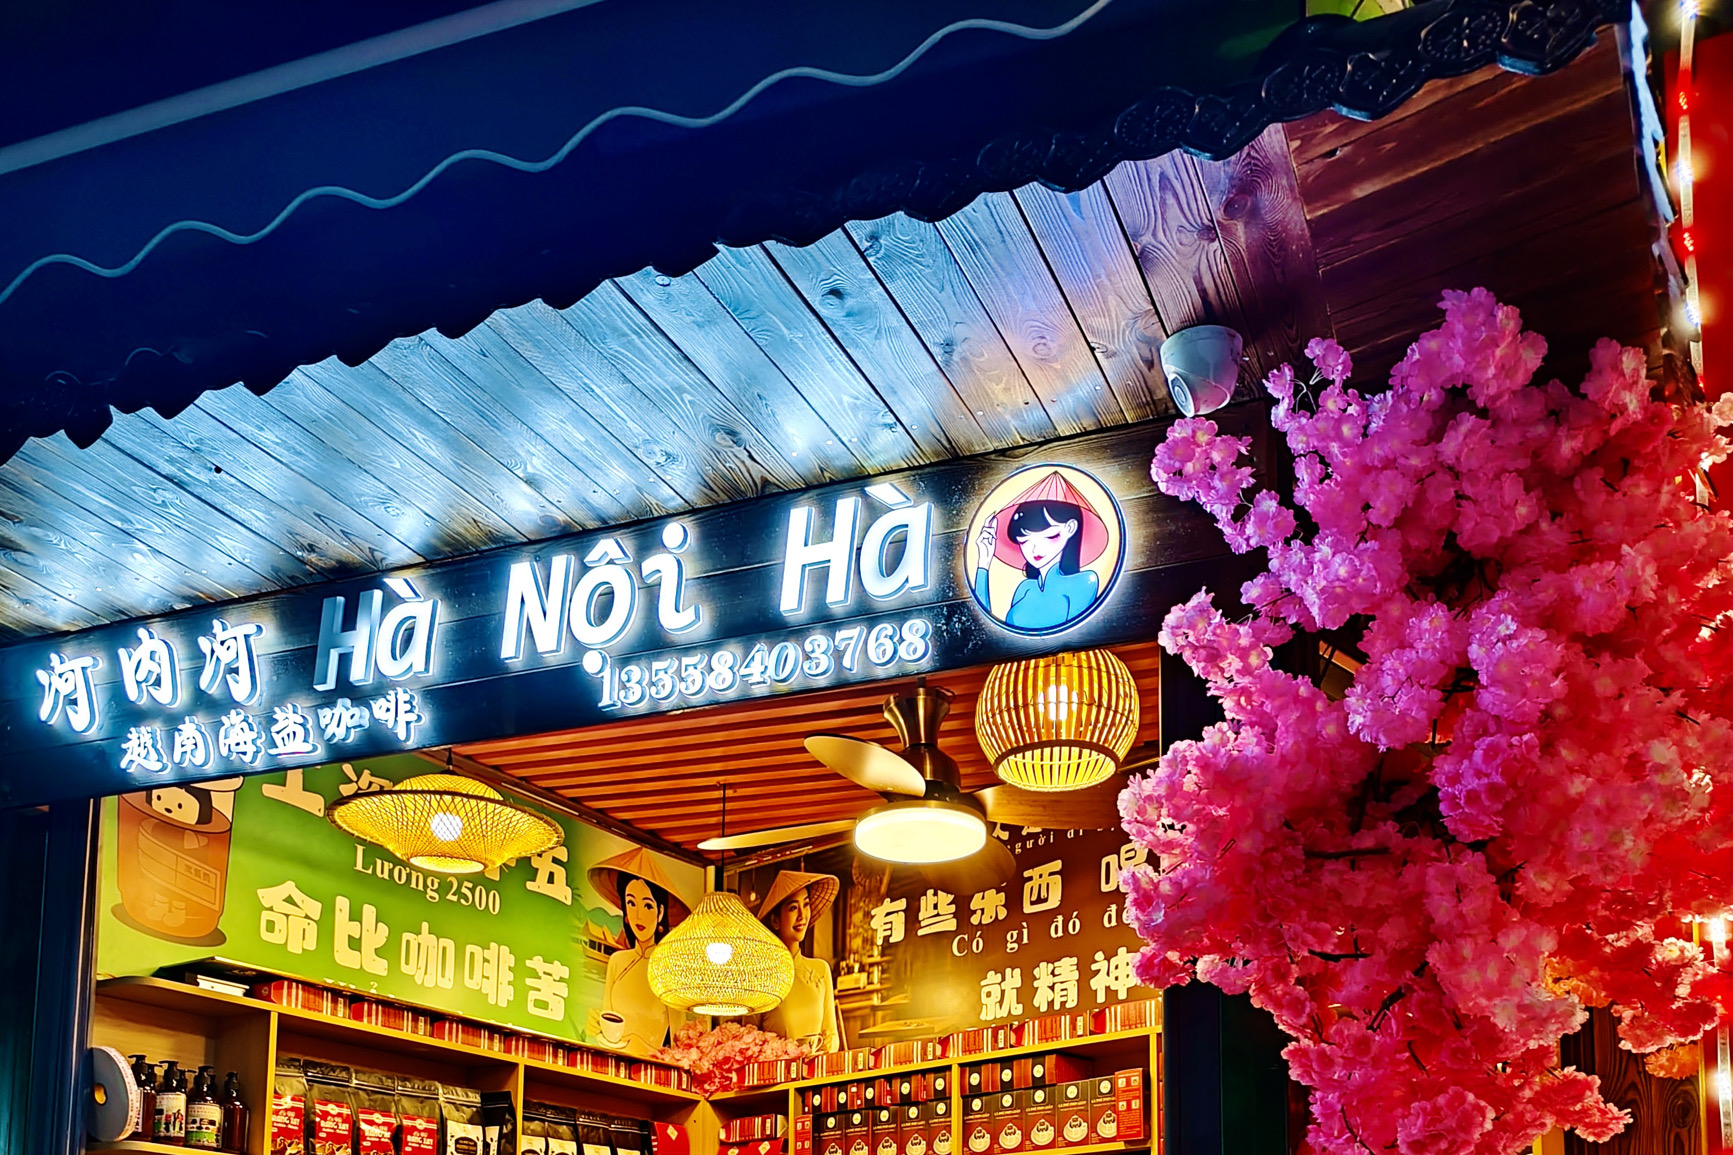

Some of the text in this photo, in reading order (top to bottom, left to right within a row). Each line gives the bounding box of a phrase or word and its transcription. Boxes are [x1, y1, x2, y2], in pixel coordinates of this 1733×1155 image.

[313, 483, 935, 691] Hà Nội Hà
[37, 618, 264, 734] 河内河
[598, 617, 932, 710] 13558403768
[120, 687, 425, 778] 越南海盐咖啡
[354, 843, 501, 915] Lương 2500
[257, 880, 570, 1021] 命比咖啡苦
[951, 930, 984, 957] Có
[1006, 921, 1029, 952] gì
[1050, 910, 1081, 938] đó
[979, 946, 1137, 1021] 就精神
